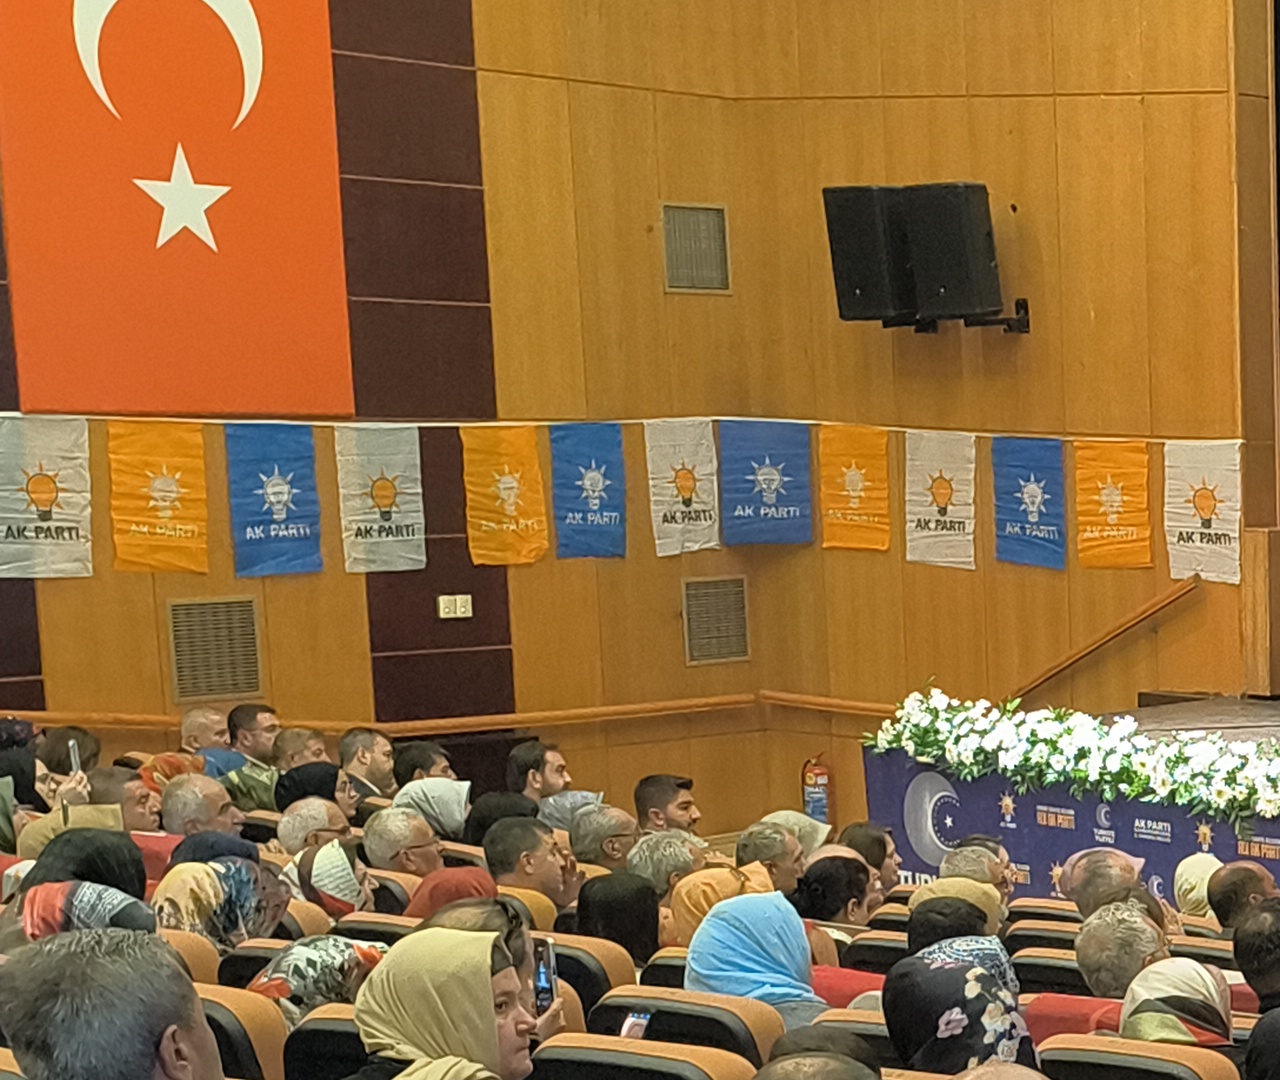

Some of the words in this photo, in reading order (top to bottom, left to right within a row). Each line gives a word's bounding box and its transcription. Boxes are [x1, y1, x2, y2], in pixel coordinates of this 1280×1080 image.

[662, 510, 677, 524] AK
[734, 505, 754, 517] AK
[565, 513, 583, 525] AK
[915, 518, 932, 532] AK
[5, 526, 28, 540] AK
[246, 525, 264, 540] AK
[355, 525, 376, 539] AK
[1177, 531, 1195, 544] AK
